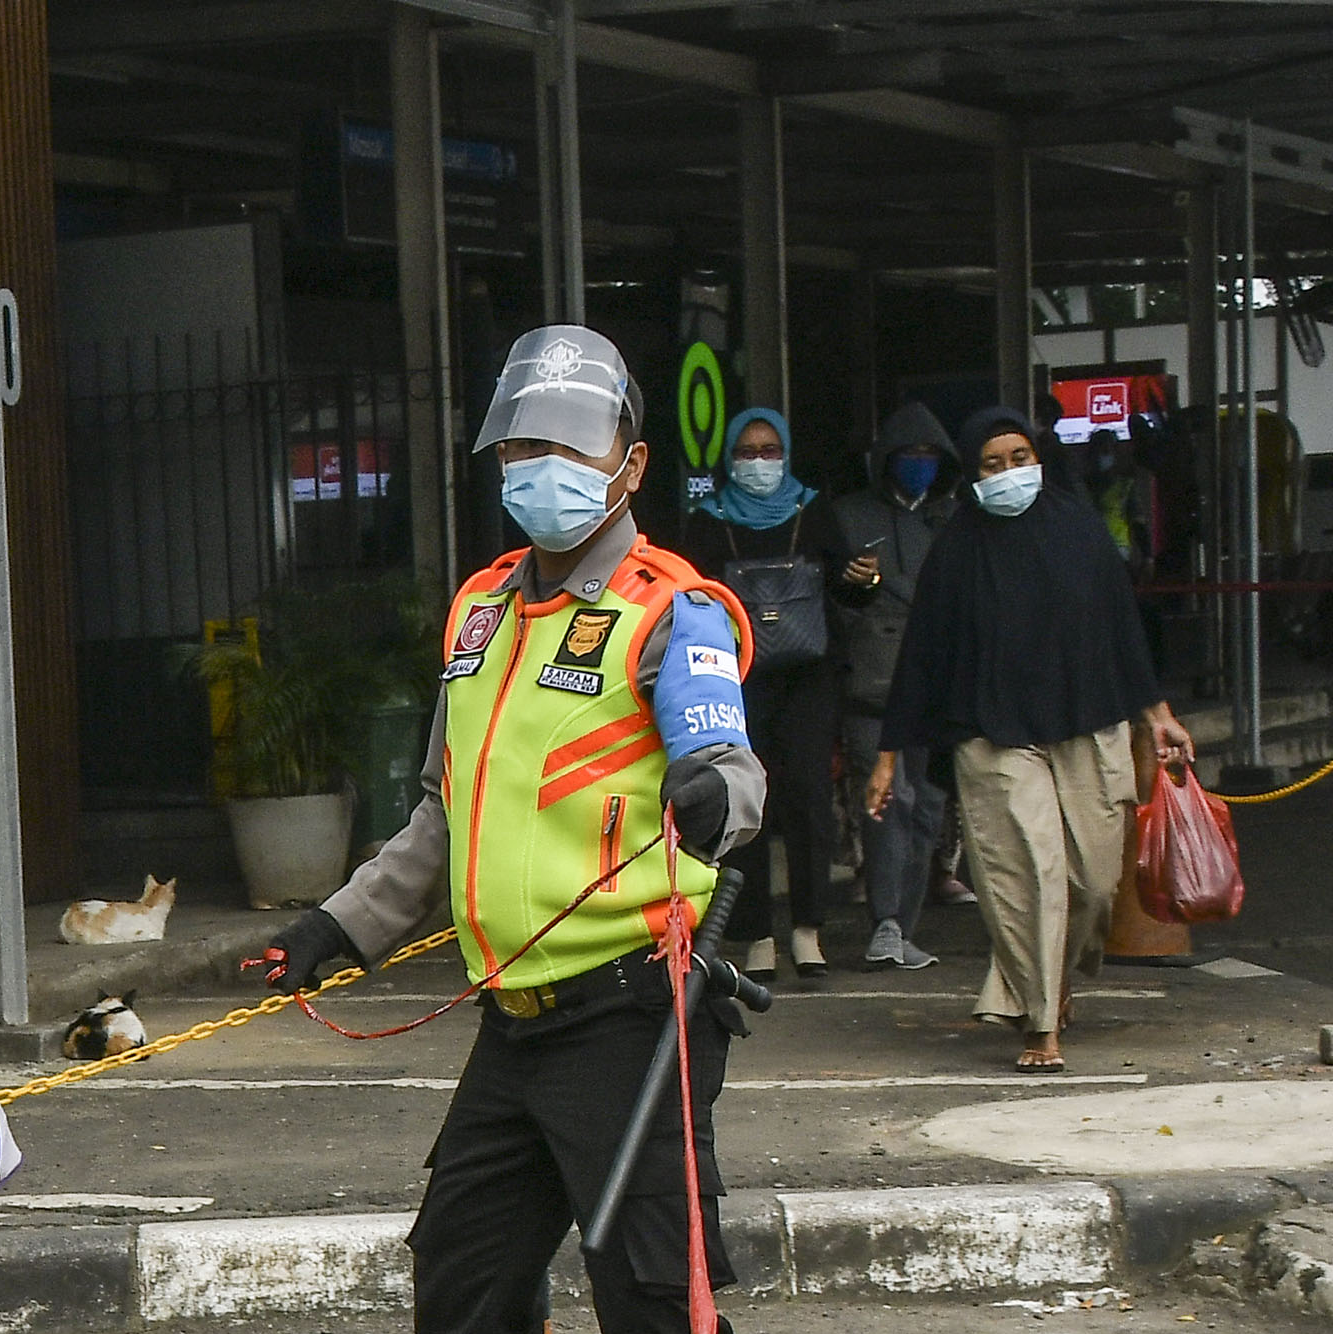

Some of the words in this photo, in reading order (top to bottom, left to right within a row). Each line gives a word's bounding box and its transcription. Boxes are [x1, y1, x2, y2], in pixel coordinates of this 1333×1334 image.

[1092, 401, 1123, 415] Link
[692, 652, 718, 665] KAI
[548, 669, 593, 687] SATPAM
